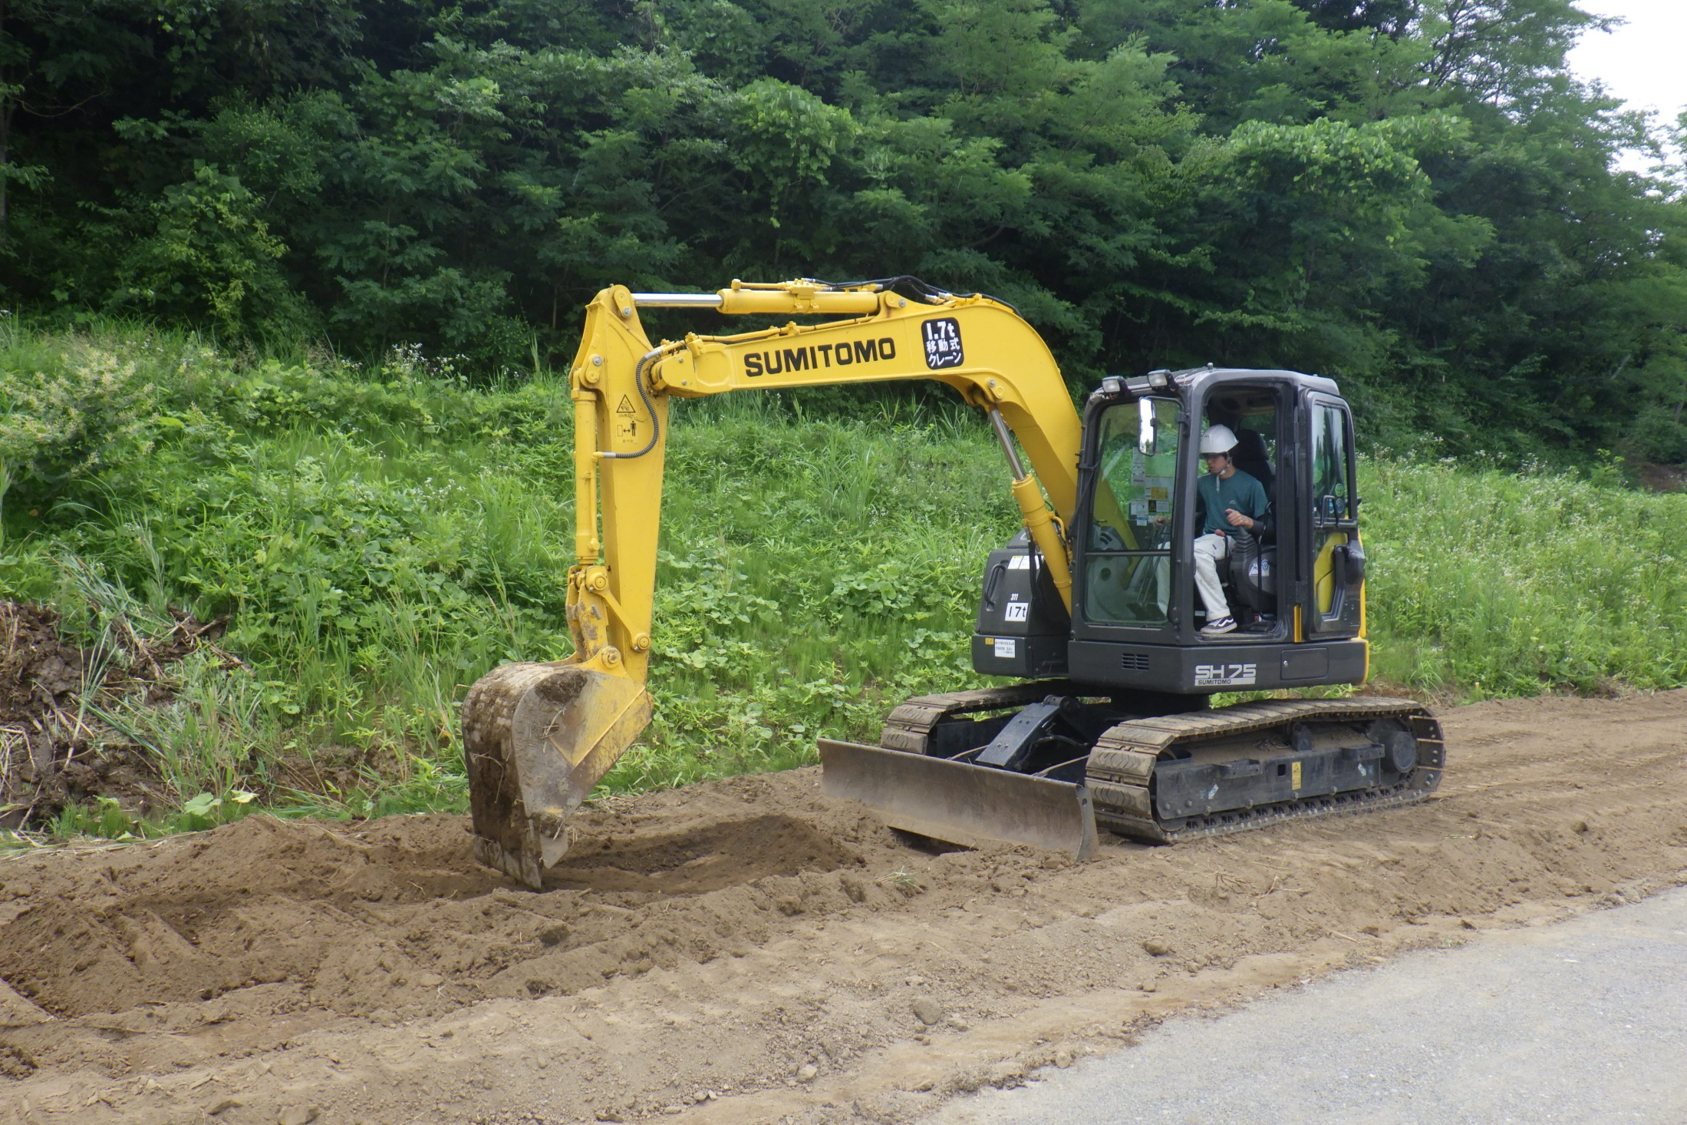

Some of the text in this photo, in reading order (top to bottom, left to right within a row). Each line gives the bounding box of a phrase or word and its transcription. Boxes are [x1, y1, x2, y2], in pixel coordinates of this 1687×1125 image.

[926, 320, 956, 340] 1.7t
[926, 337, 960, 354] 移動式
[744, 337, 896, 377] SUMITOMO
[928, 351, 962, 367] クレーン
